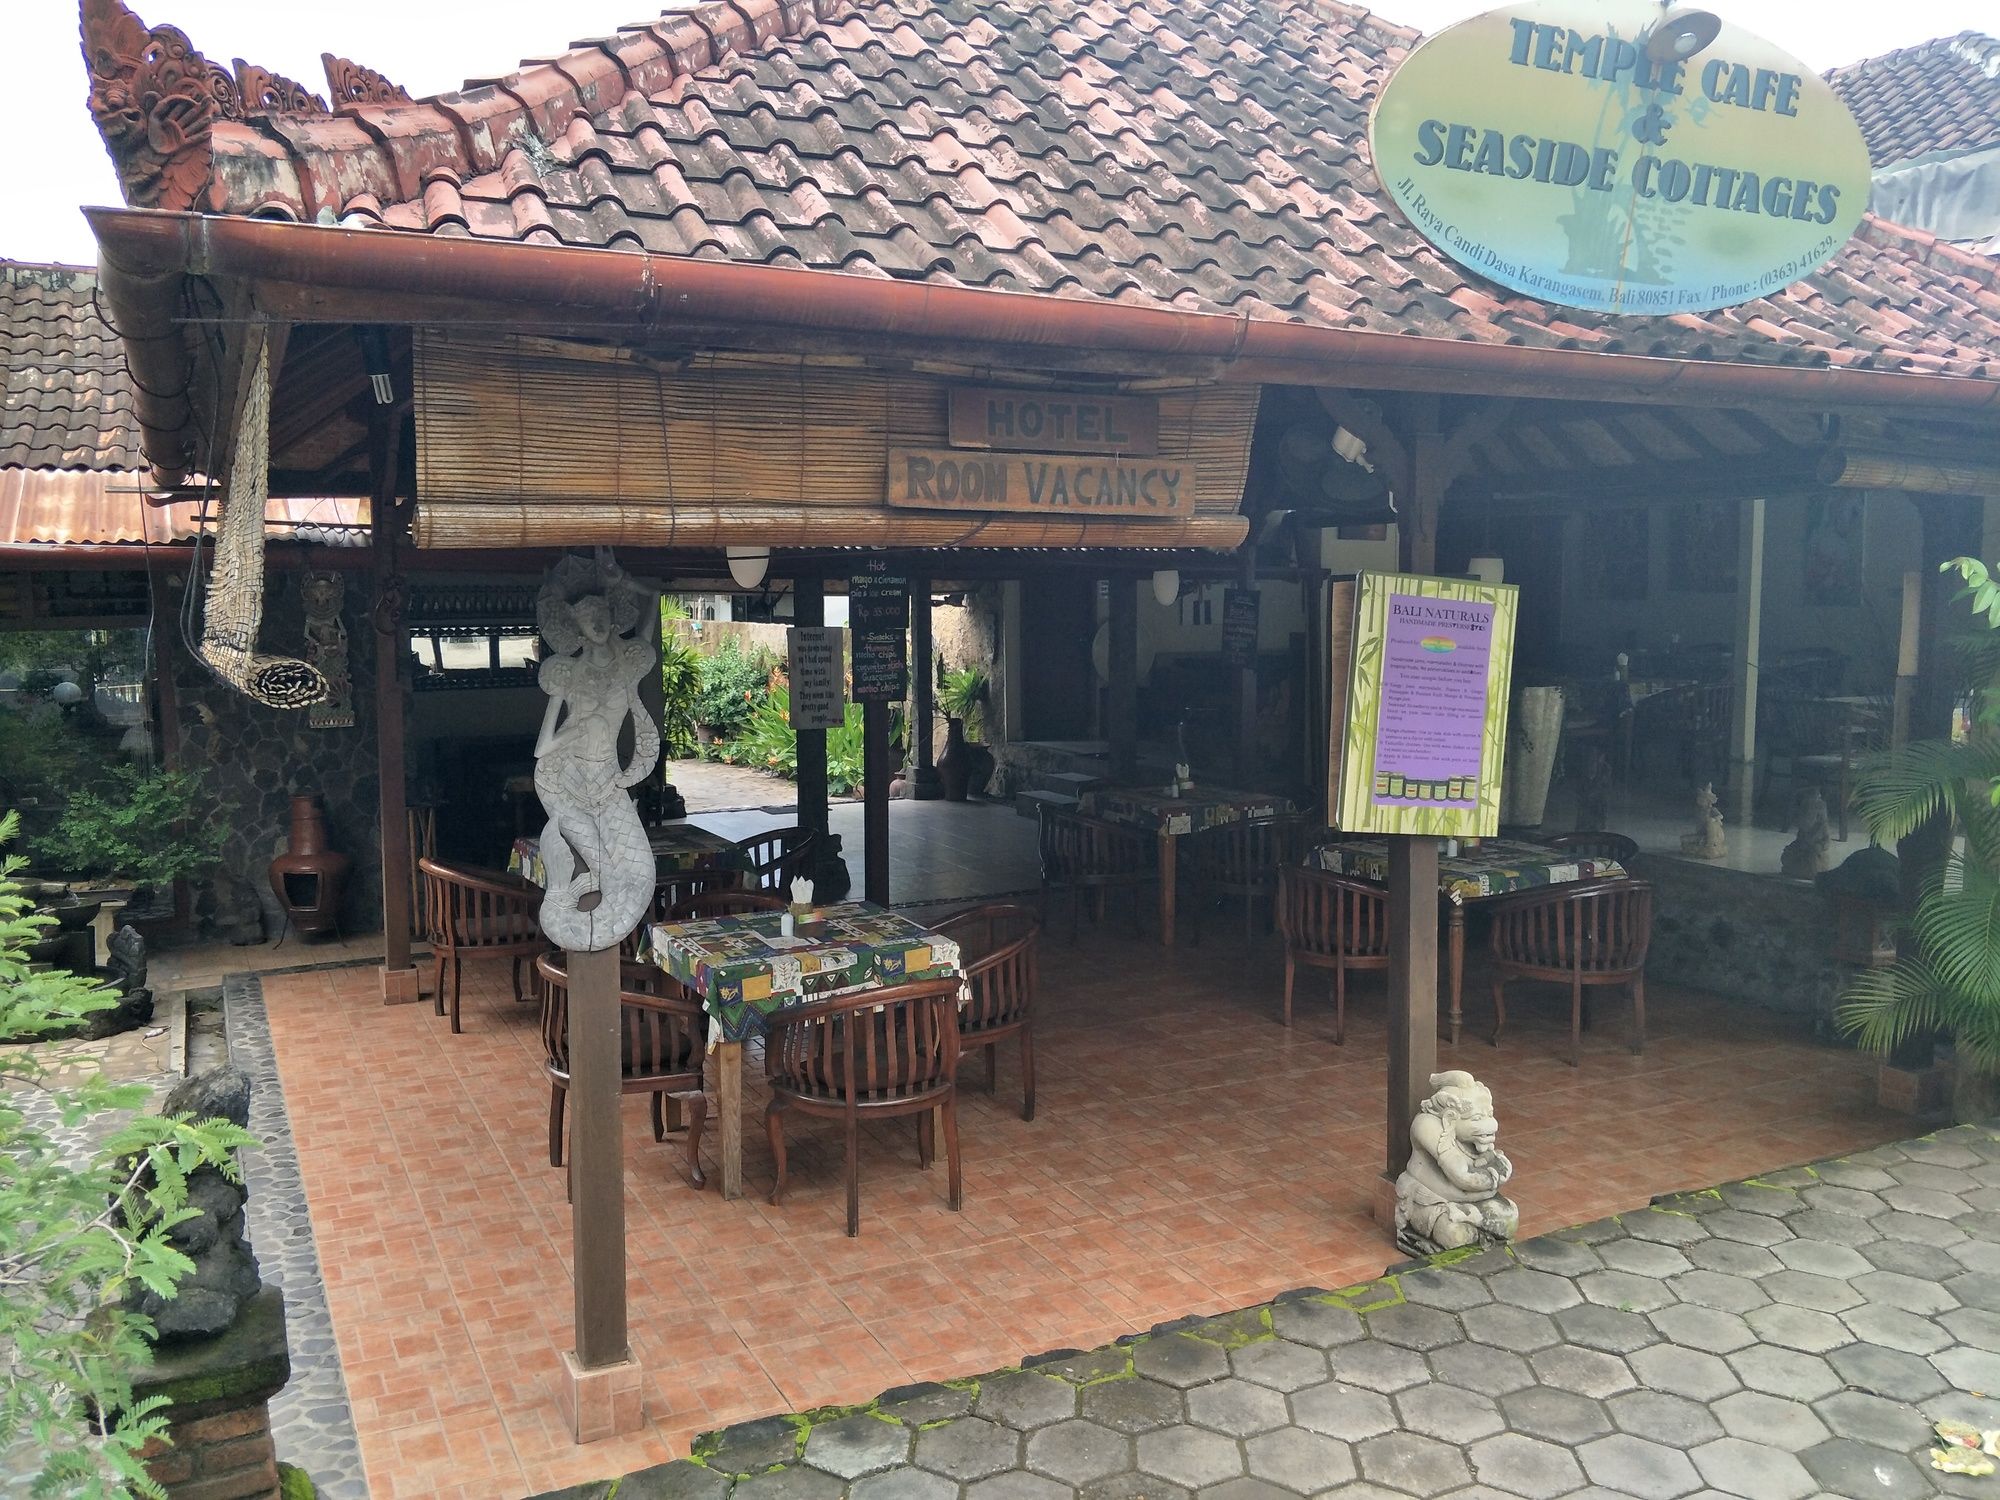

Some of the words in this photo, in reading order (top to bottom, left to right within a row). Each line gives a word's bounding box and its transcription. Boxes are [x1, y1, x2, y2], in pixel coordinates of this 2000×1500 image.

[1509, 17, 1685, 95] TEMPLE
[1702, 58, 1802, 117] CAFE
[1631, 103, 1672, 146] &
[1413, 119, 1618, 193] SEASIDE
[1631, 155, 1841, 225] COTTAGES
[1411, 193, 1443, 233] Raya
[1444, 225, 1486, 261] Candi
[1483, 250, 1516, 277] Dasa
[1609, 287, 1636, 305] Bali
[1637, 290, 1674, 306] 80851
[1677, 289, 1701, 305] Fax
[1711, 281, 1749, 301] Phone
[1760, 260, 1798, 290] (0363)
[987, 400, 1129, 444] HOTEL
[906, 455, 1008, 503] ROOM
[1023, 461, 1181, 508] VACANCY
[1393, 604, 1422, 617] BALI
[1425, 607, 1489, 624] NATURALS
